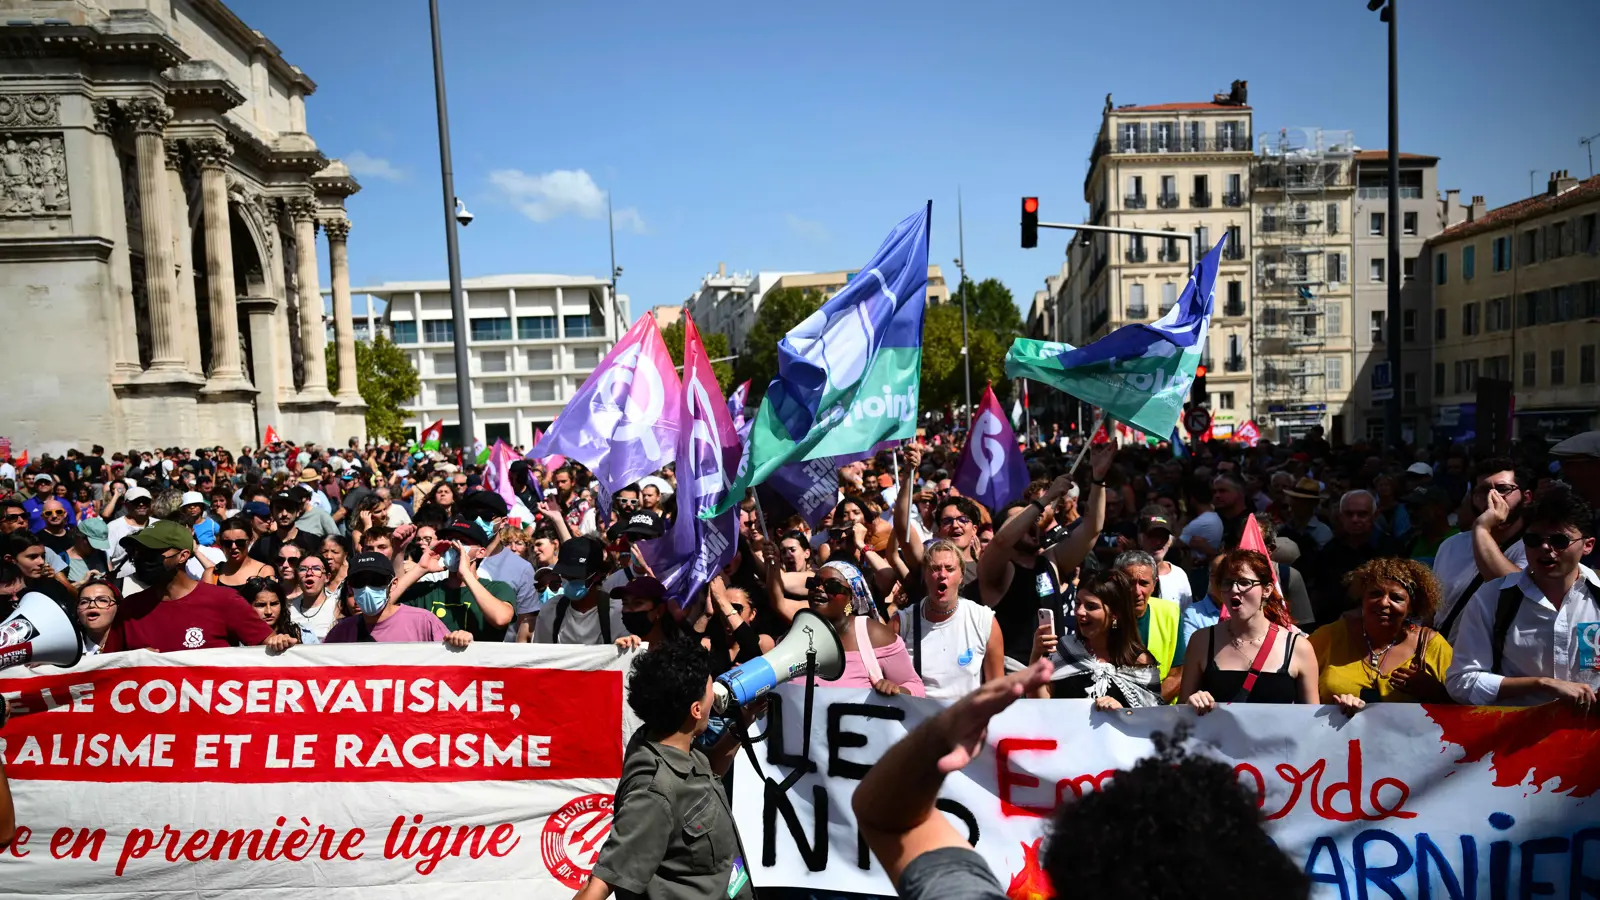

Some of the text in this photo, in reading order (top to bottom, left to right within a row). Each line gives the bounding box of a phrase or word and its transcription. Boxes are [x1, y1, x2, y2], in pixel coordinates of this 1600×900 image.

[41, 683, 94, 713] LE
[110, 679, 521, 720] CONSERVATISME,
[194, 734, 251, 768] ET
[265, 734, 318, 769] LE
[335, 733, 551, 768] RACISME
[553, 798, 593, 829] JEUNE
[50, 826, 107, 860] en
[115, 816, 366, 877] première
[384, 814, 520, 875] ligne
